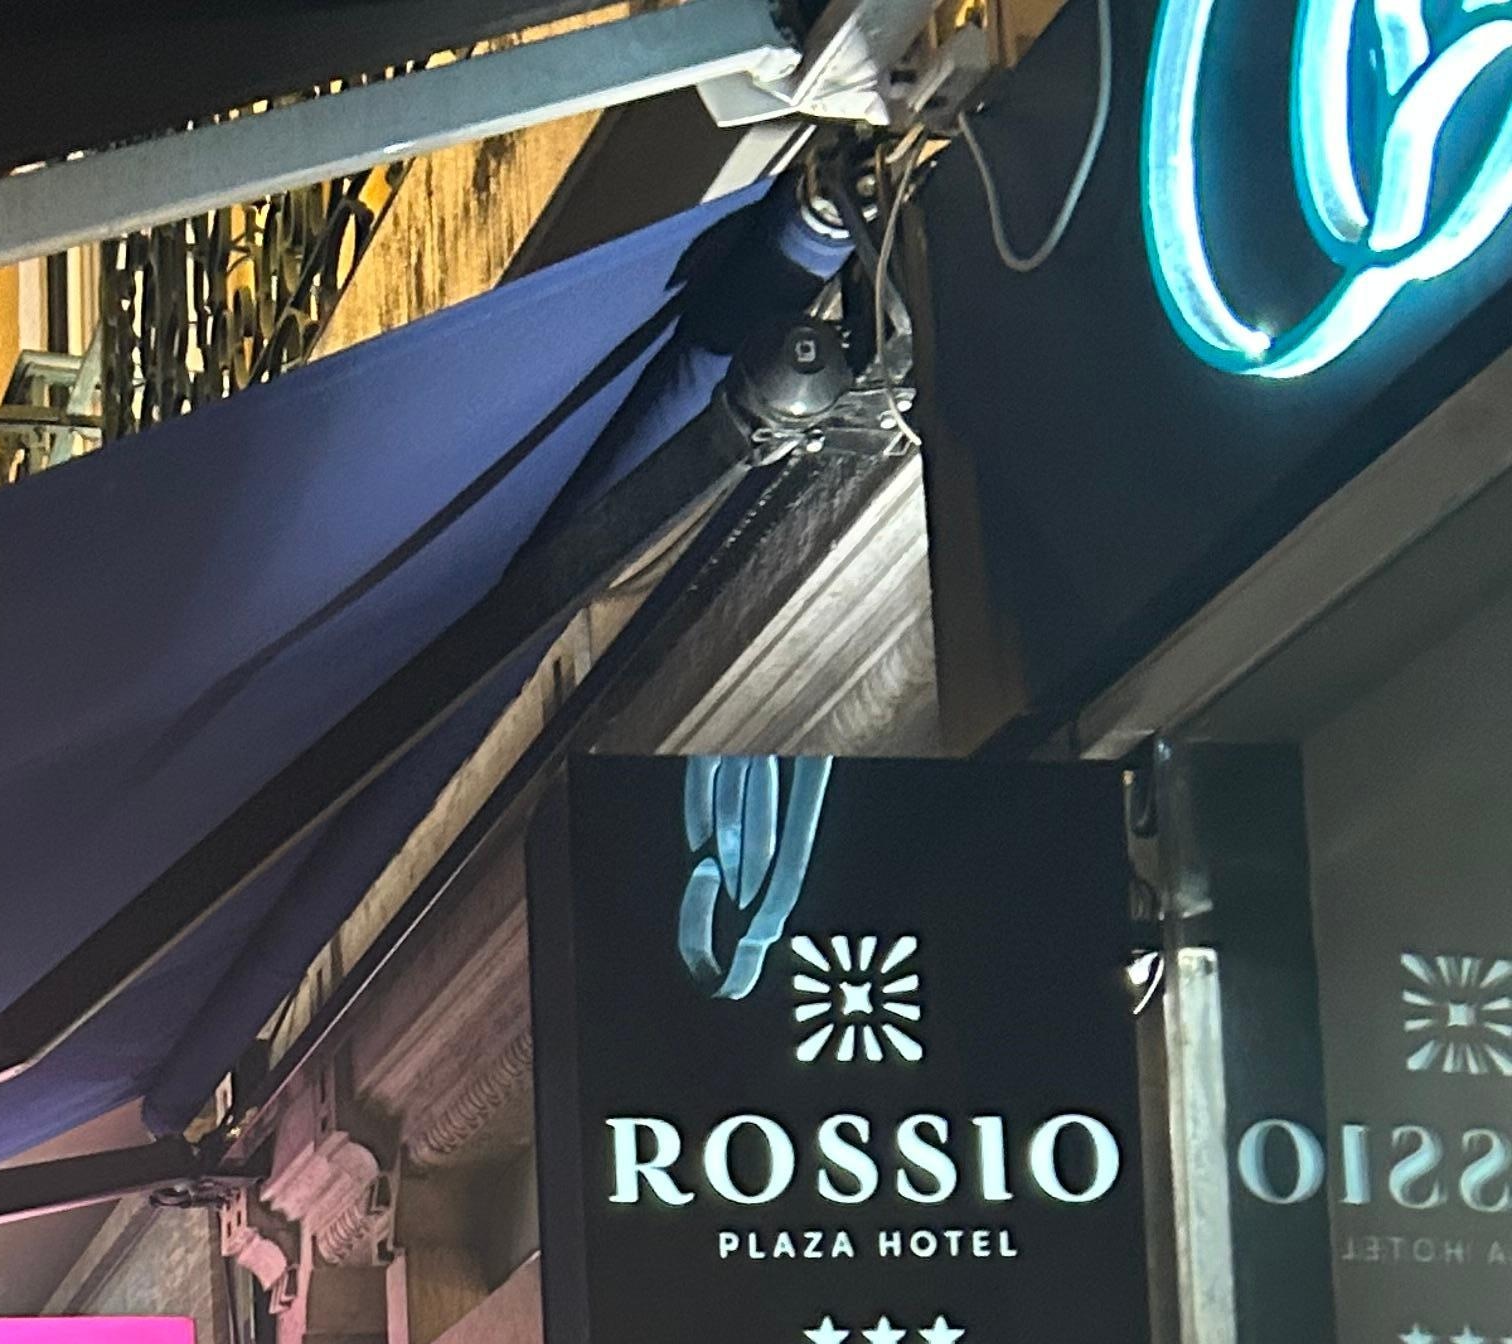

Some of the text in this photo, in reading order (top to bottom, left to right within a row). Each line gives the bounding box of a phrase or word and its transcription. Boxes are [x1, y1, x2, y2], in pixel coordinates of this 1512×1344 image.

[605, 1113, 1121, 1206] ROSSIO
[718, 1230, 1019, 1259] PLAZA HOTEL
